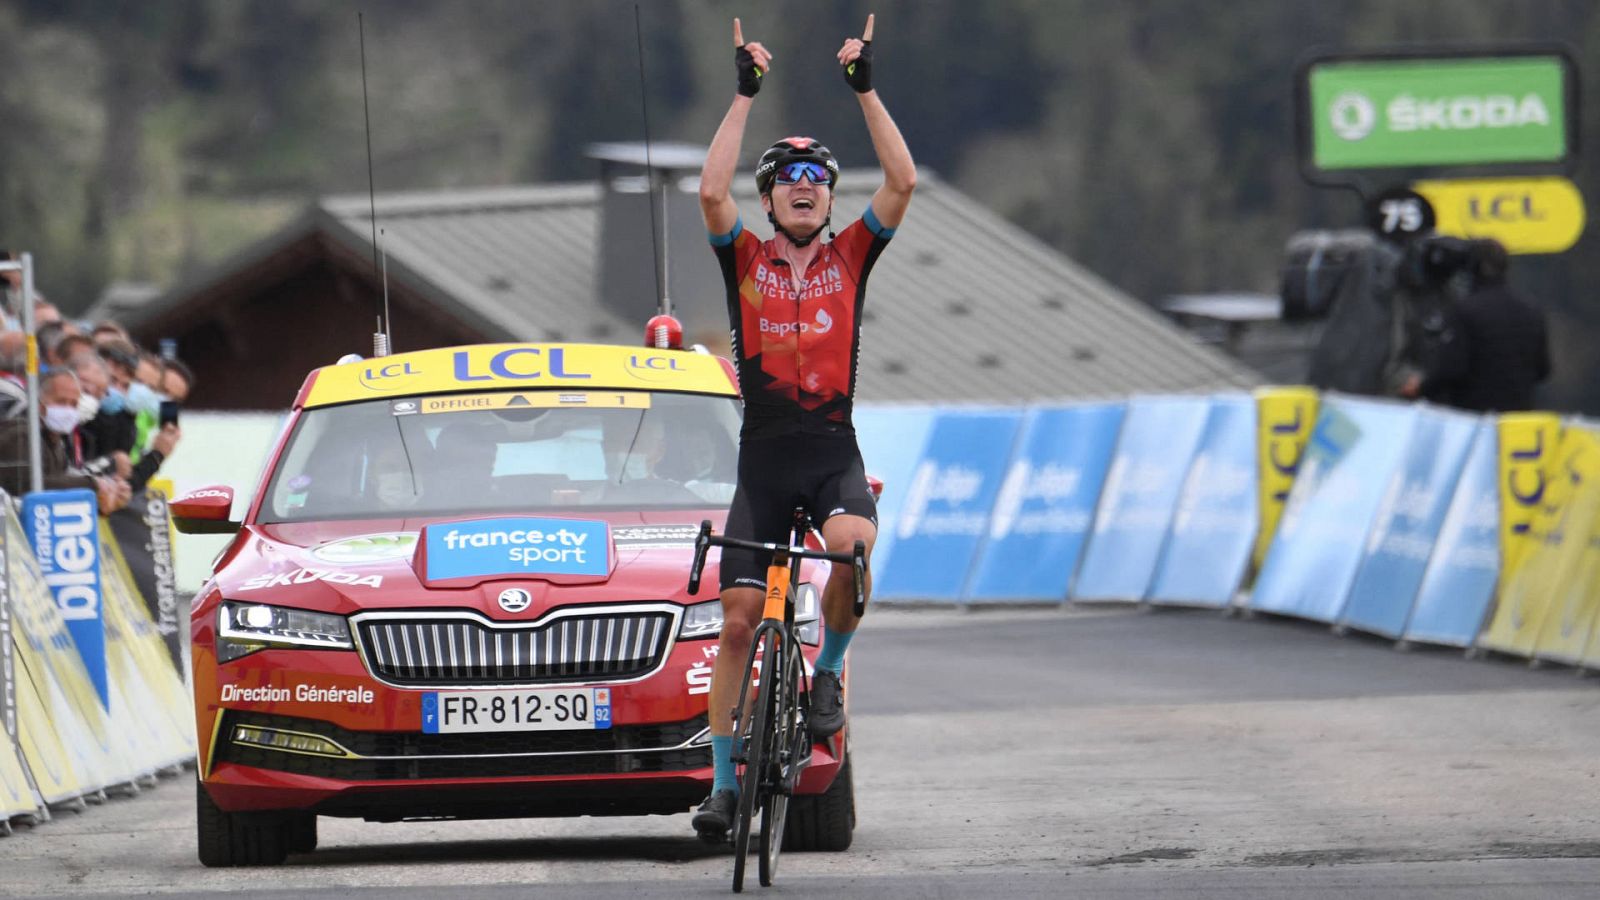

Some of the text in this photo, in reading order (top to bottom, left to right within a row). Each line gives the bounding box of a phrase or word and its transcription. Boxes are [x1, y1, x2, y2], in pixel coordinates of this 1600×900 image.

[1387, 92, 1548, 132] ŠKODA
[1380, 199, 1423, 233] 75
[1467, 195, 1547, 222] LCL
[755, 280, 843, 301] VICTORIOUS
[760, 317, 809, 338] Bapco
[364, 362, 422, 381] LCL
[453, 348, 592, 382] LCL
[630, 355, 687, 372] LCL
[429, 398, 493, 410] OFFICIEL
[44, 500, 98, 620] bleu
[509, 547, 587, 567] sport
[220, 685, 375, 704] Direction Générale
[427, 714, 434, 724] F
[443, 694, 589, 726] FR-812-SQ
[594, 708, 610, 721] 92
